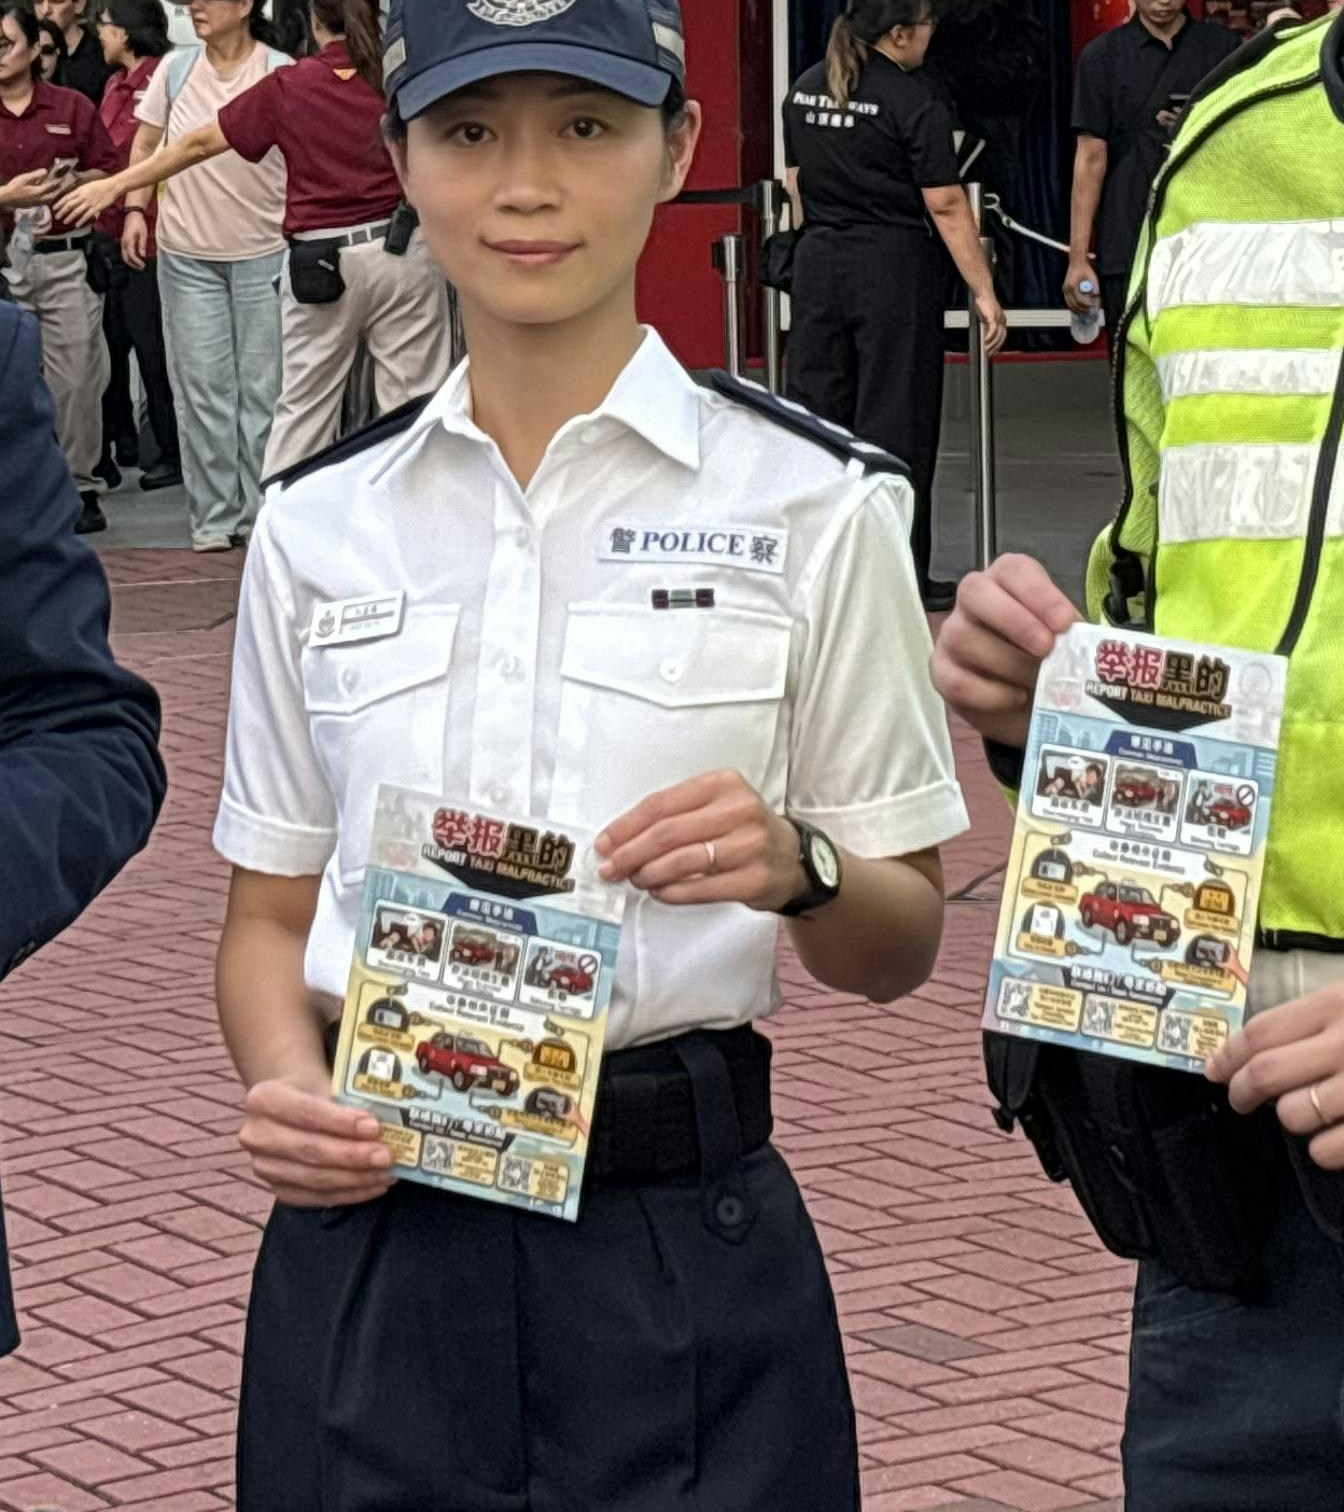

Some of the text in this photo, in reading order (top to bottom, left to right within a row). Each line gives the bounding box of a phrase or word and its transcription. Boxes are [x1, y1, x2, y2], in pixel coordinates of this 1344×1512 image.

[609, 527, 779, 565] 警 POLICE 察
[1085, 679, 1128, 701] REPORT
[1130, 689, 1155, 705] TAXI
[422, 844, 468, 866] REPORT
[469, 856, 496, 873] TAXI
